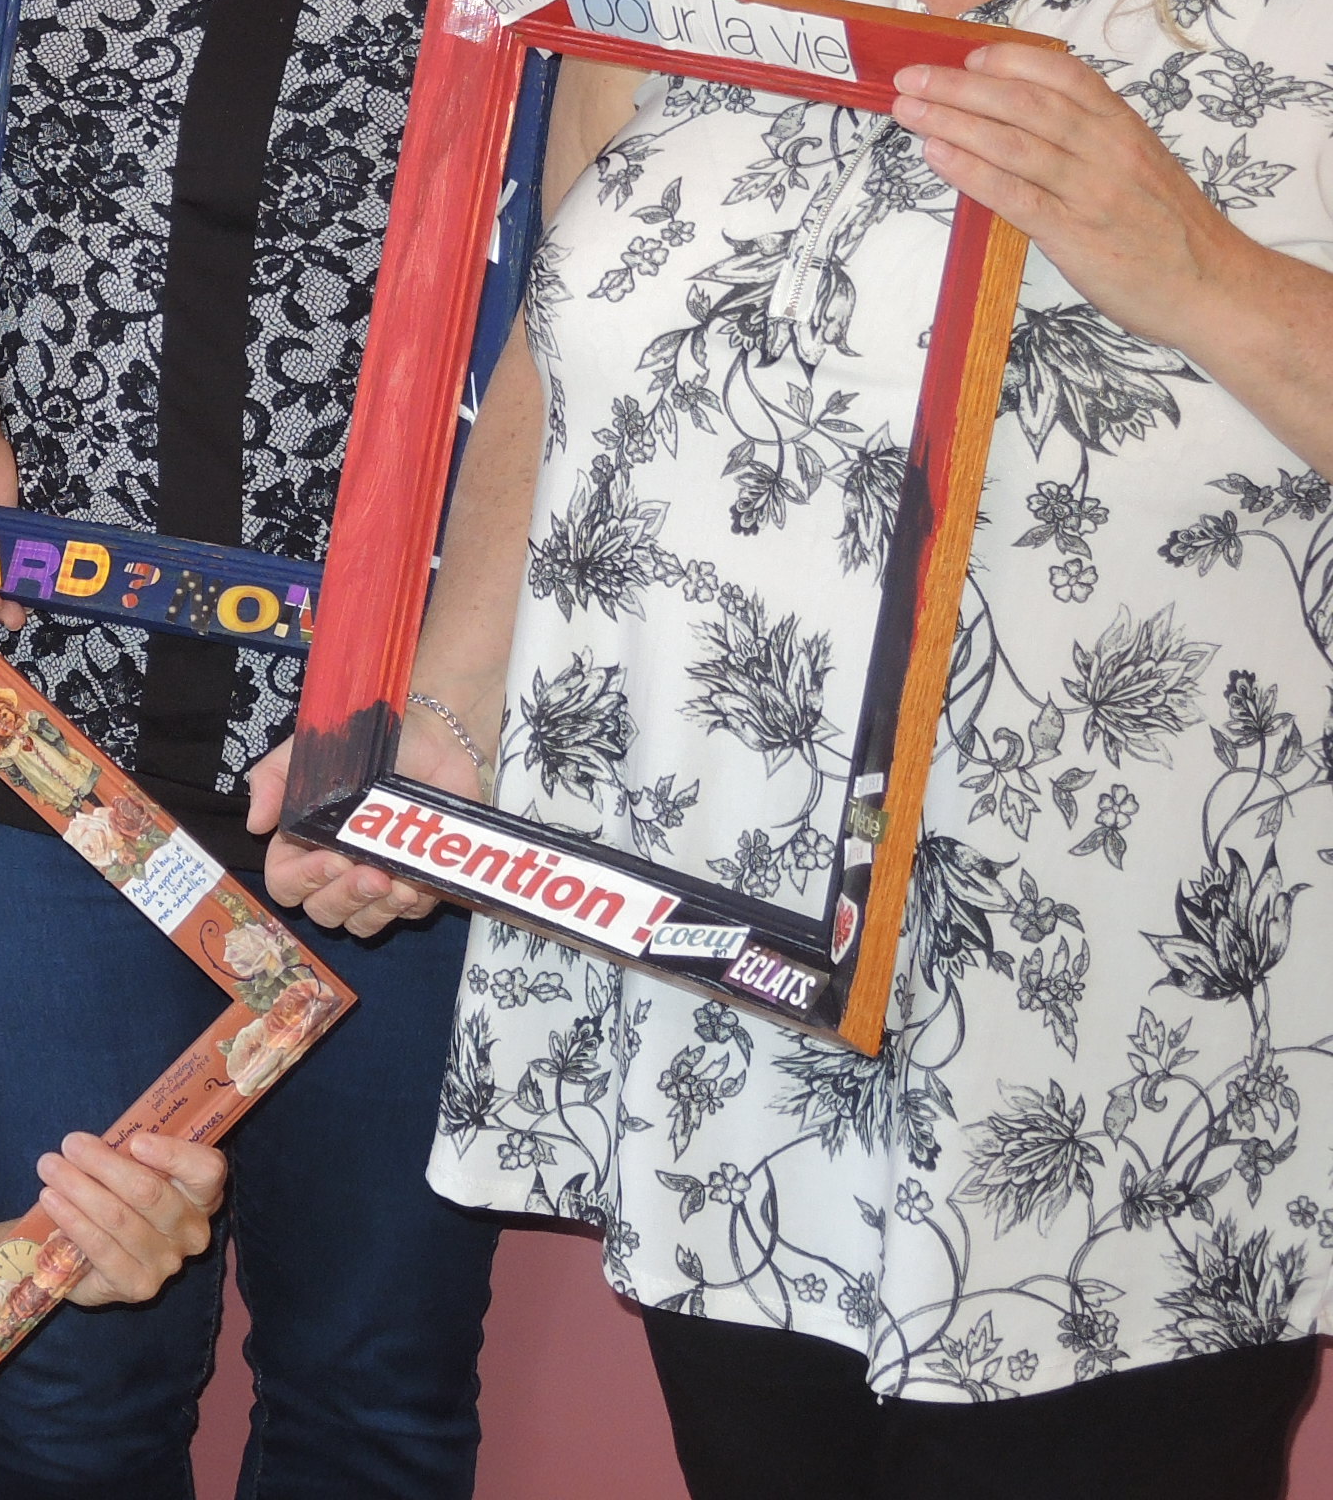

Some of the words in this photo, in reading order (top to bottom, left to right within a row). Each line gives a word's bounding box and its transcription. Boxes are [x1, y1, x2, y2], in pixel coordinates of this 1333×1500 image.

[715, 0, 765, 60] la
[769, 18, 853, 76] vie
[174, 845, 183, 860] je
[348, 799, 628, 931] attention
[141, 890, 159, 907] dois
[158, 855, 194, 892] apprendre
[189, 861, 205, 876] avec
[158, 908, 173, 924] mes
[653, 925, 749, 950] coeur
[729, 946, 817, 1010] ÉCLATS.
[159, 1096, 189, 1125] sociales
